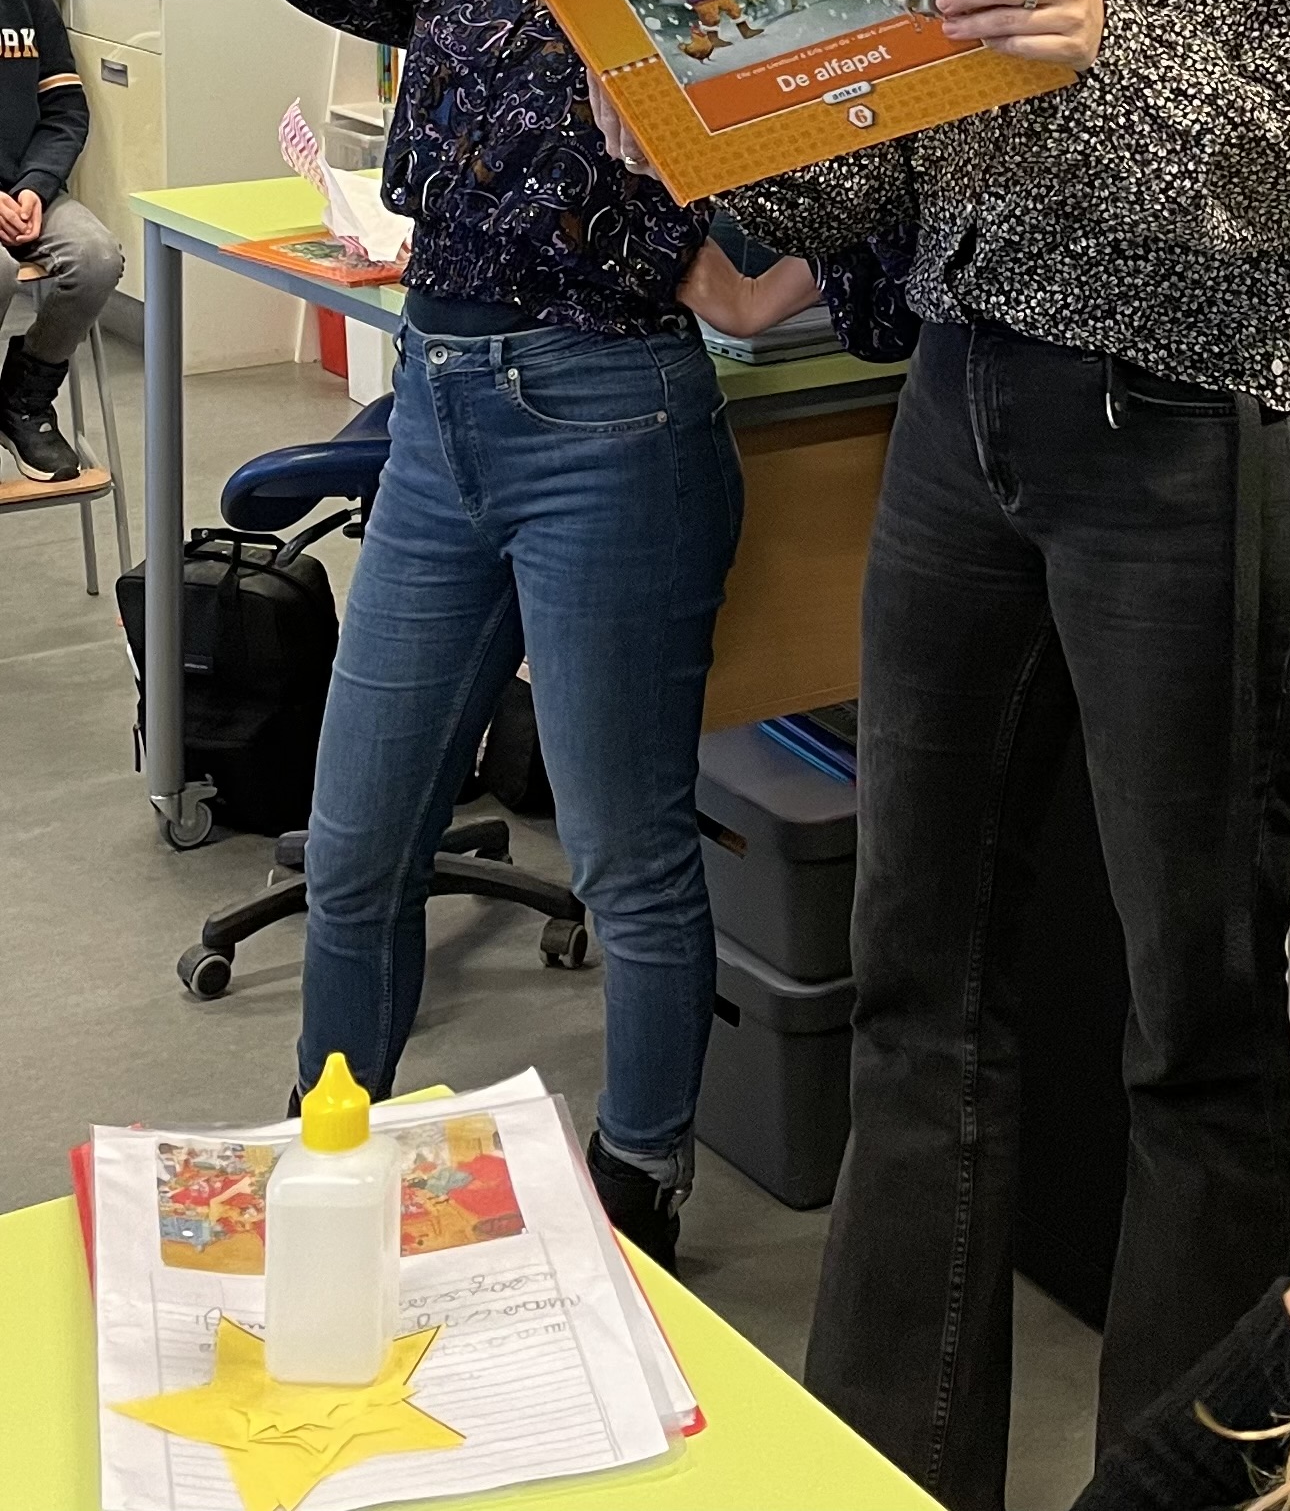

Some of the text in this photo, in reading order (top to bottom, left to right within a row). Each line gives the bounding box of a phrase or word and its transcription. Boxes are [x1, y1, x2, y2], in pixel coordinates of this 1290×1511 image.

[0, 28, 39, 58] RK
[776, 73, 810, 93] De
[813, 44, 892, 82] alfapet
[831, 85, 863, 102] anker
[854, 108, 867, 124] 6
